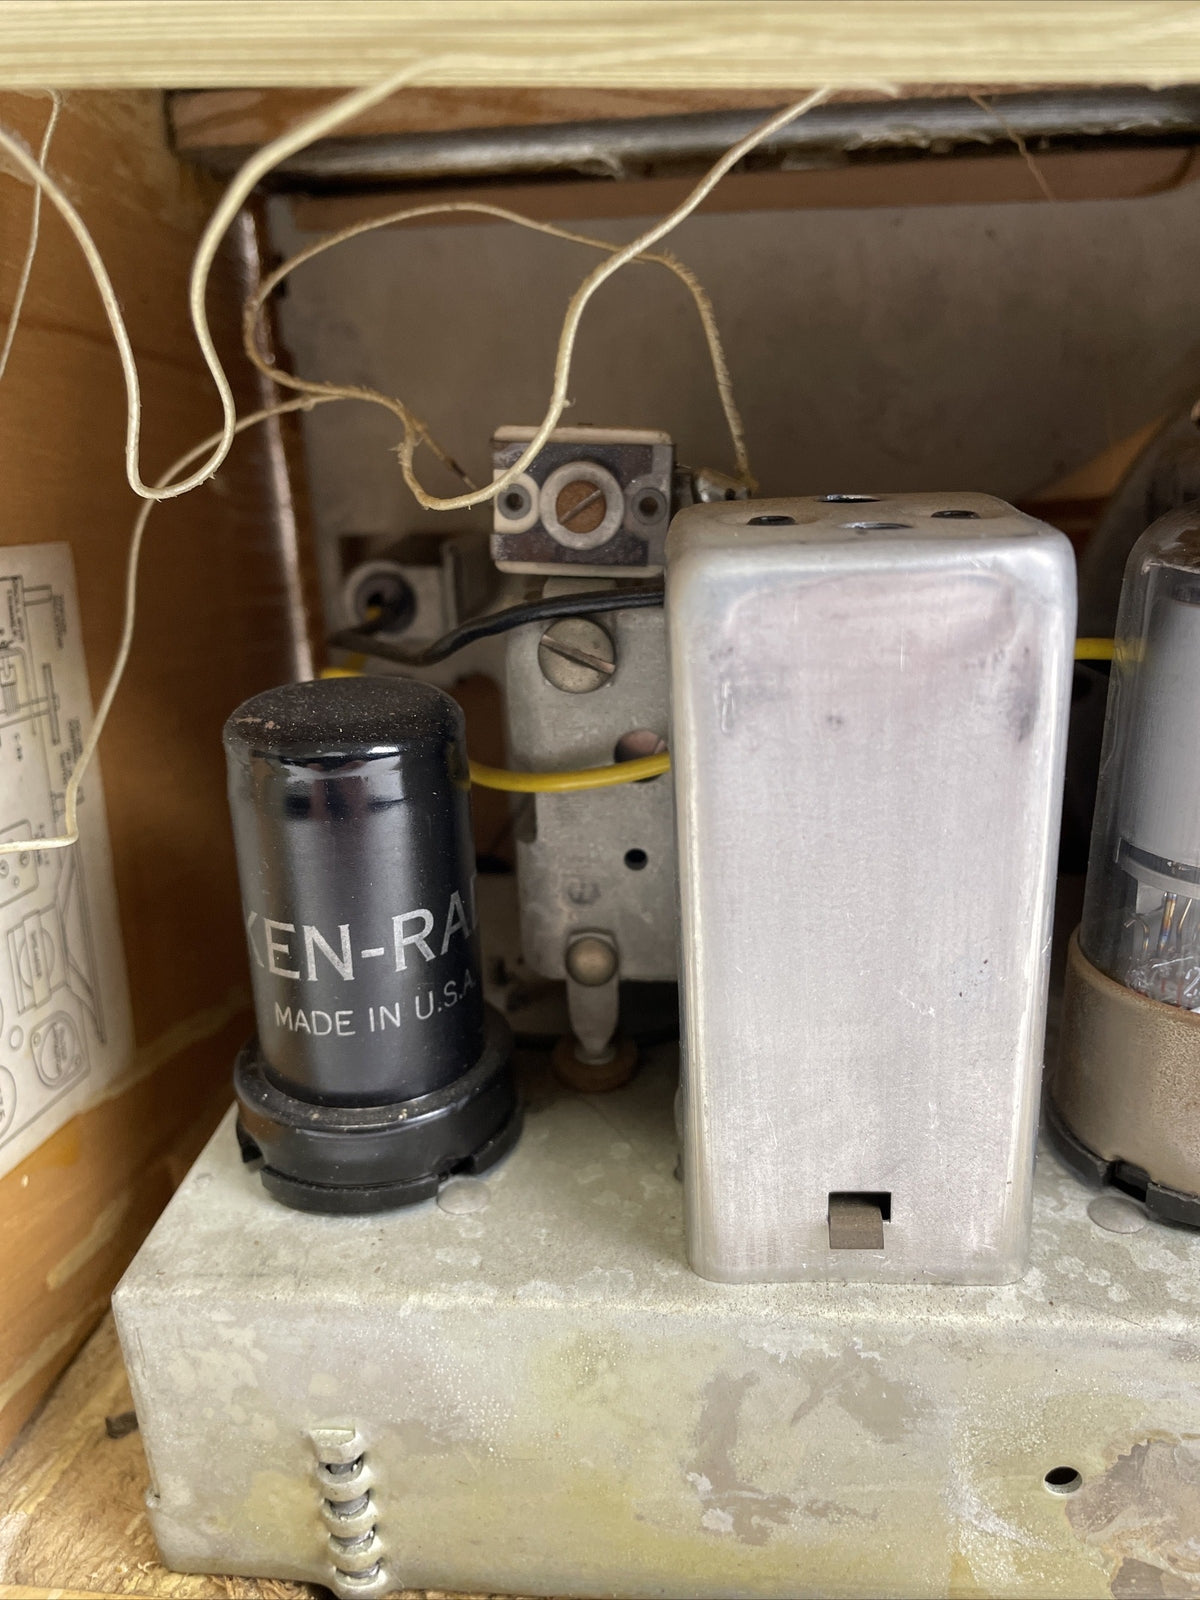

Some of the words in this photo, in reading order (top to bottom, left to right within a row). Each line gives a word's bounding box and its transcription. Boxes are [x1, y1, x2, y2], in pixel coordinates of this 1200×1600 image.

[247, 880, 476, 981] KEN-RA
[274, 1001, 356, 1036] MADE
[368, 1002, 401, 1032] IN
